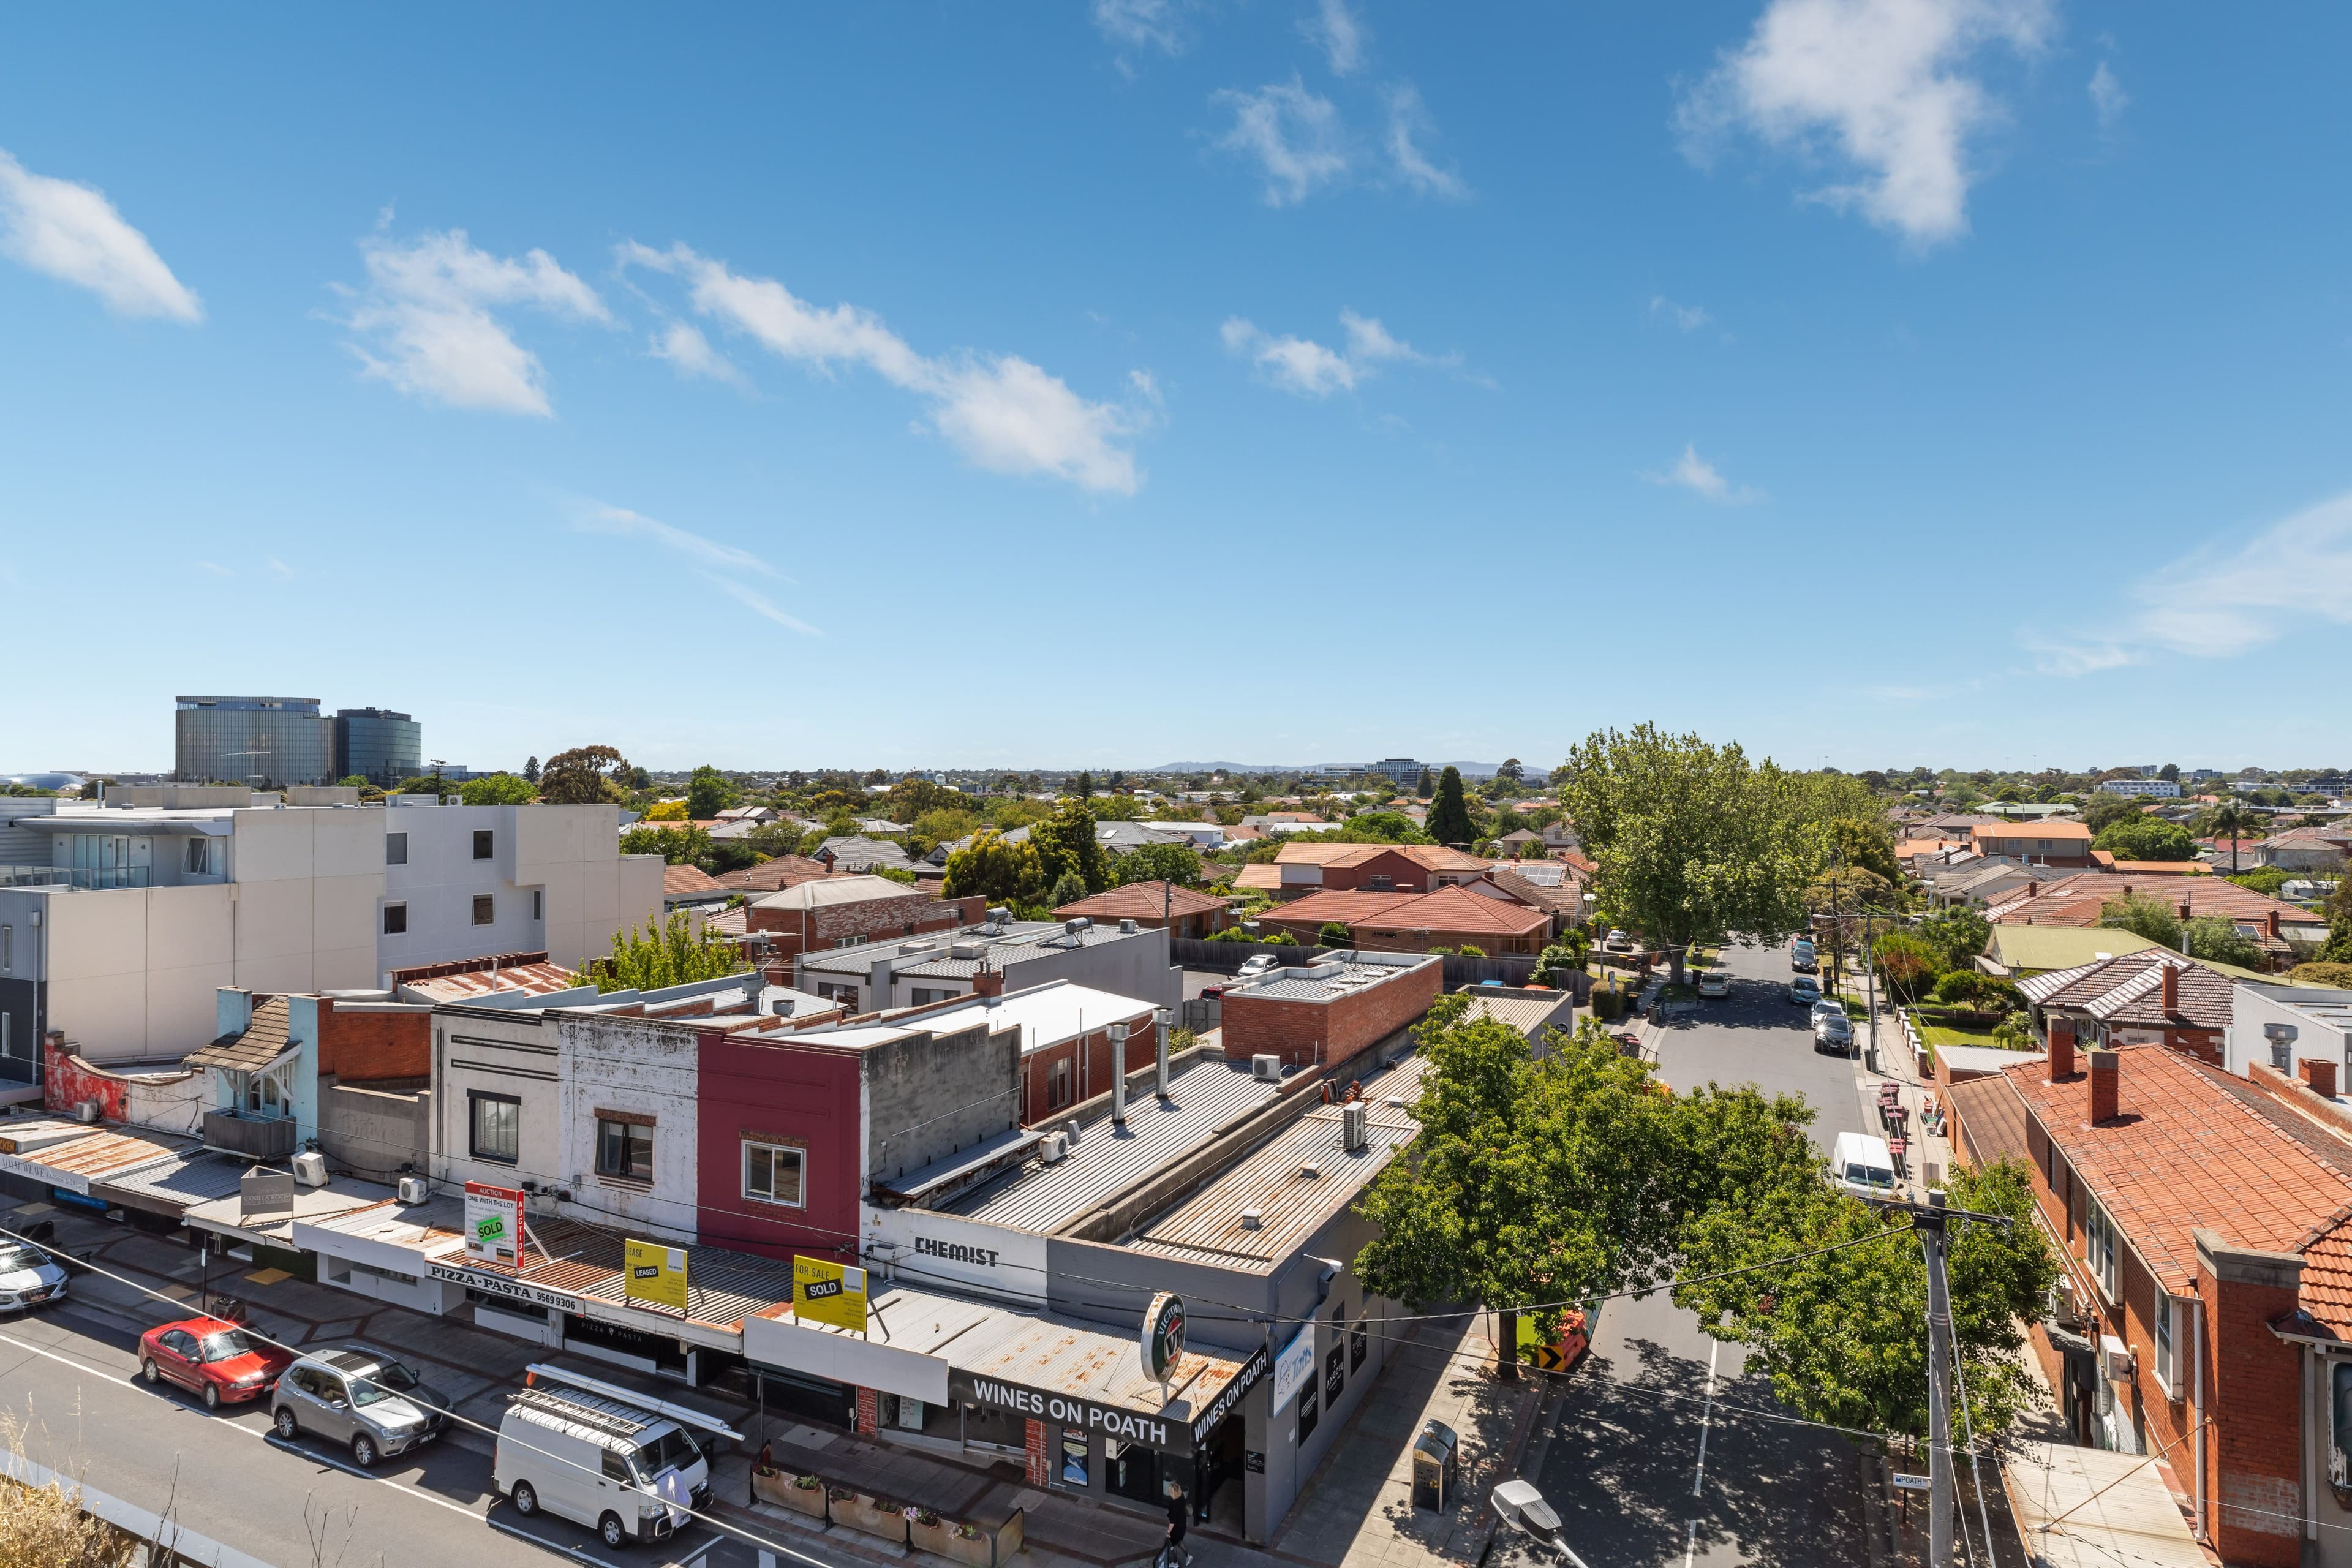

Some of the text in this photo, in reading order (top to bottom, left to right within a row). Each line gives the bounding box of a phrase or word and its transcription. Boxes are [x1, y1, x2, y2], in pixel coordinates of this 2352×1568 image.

[480, 1188, 502, 1196] AUCTION
[478, 1221, 503, 1238] SOLD
[626, 1246, 642, 1258] LEASE
[915, 1237, 999, 1267] CHEMIST
[796, 1264, 830, 1280] FOR SALE
[810, 1283, 837, 1296] SOLD
[537, 1292, 554, 1305] 9569
[556, 1298, 575, 1310] 9306
[581, 1322, 603, 1333] PIZZA
[617, 1331, 642, 1342] PASTA
[1195, 1351, 1267, 1442] WINES ON POATH
[974, 1379, 1166, 1445] WINES ON POATH
[1901, 1476, 1922, 1485] POATH
